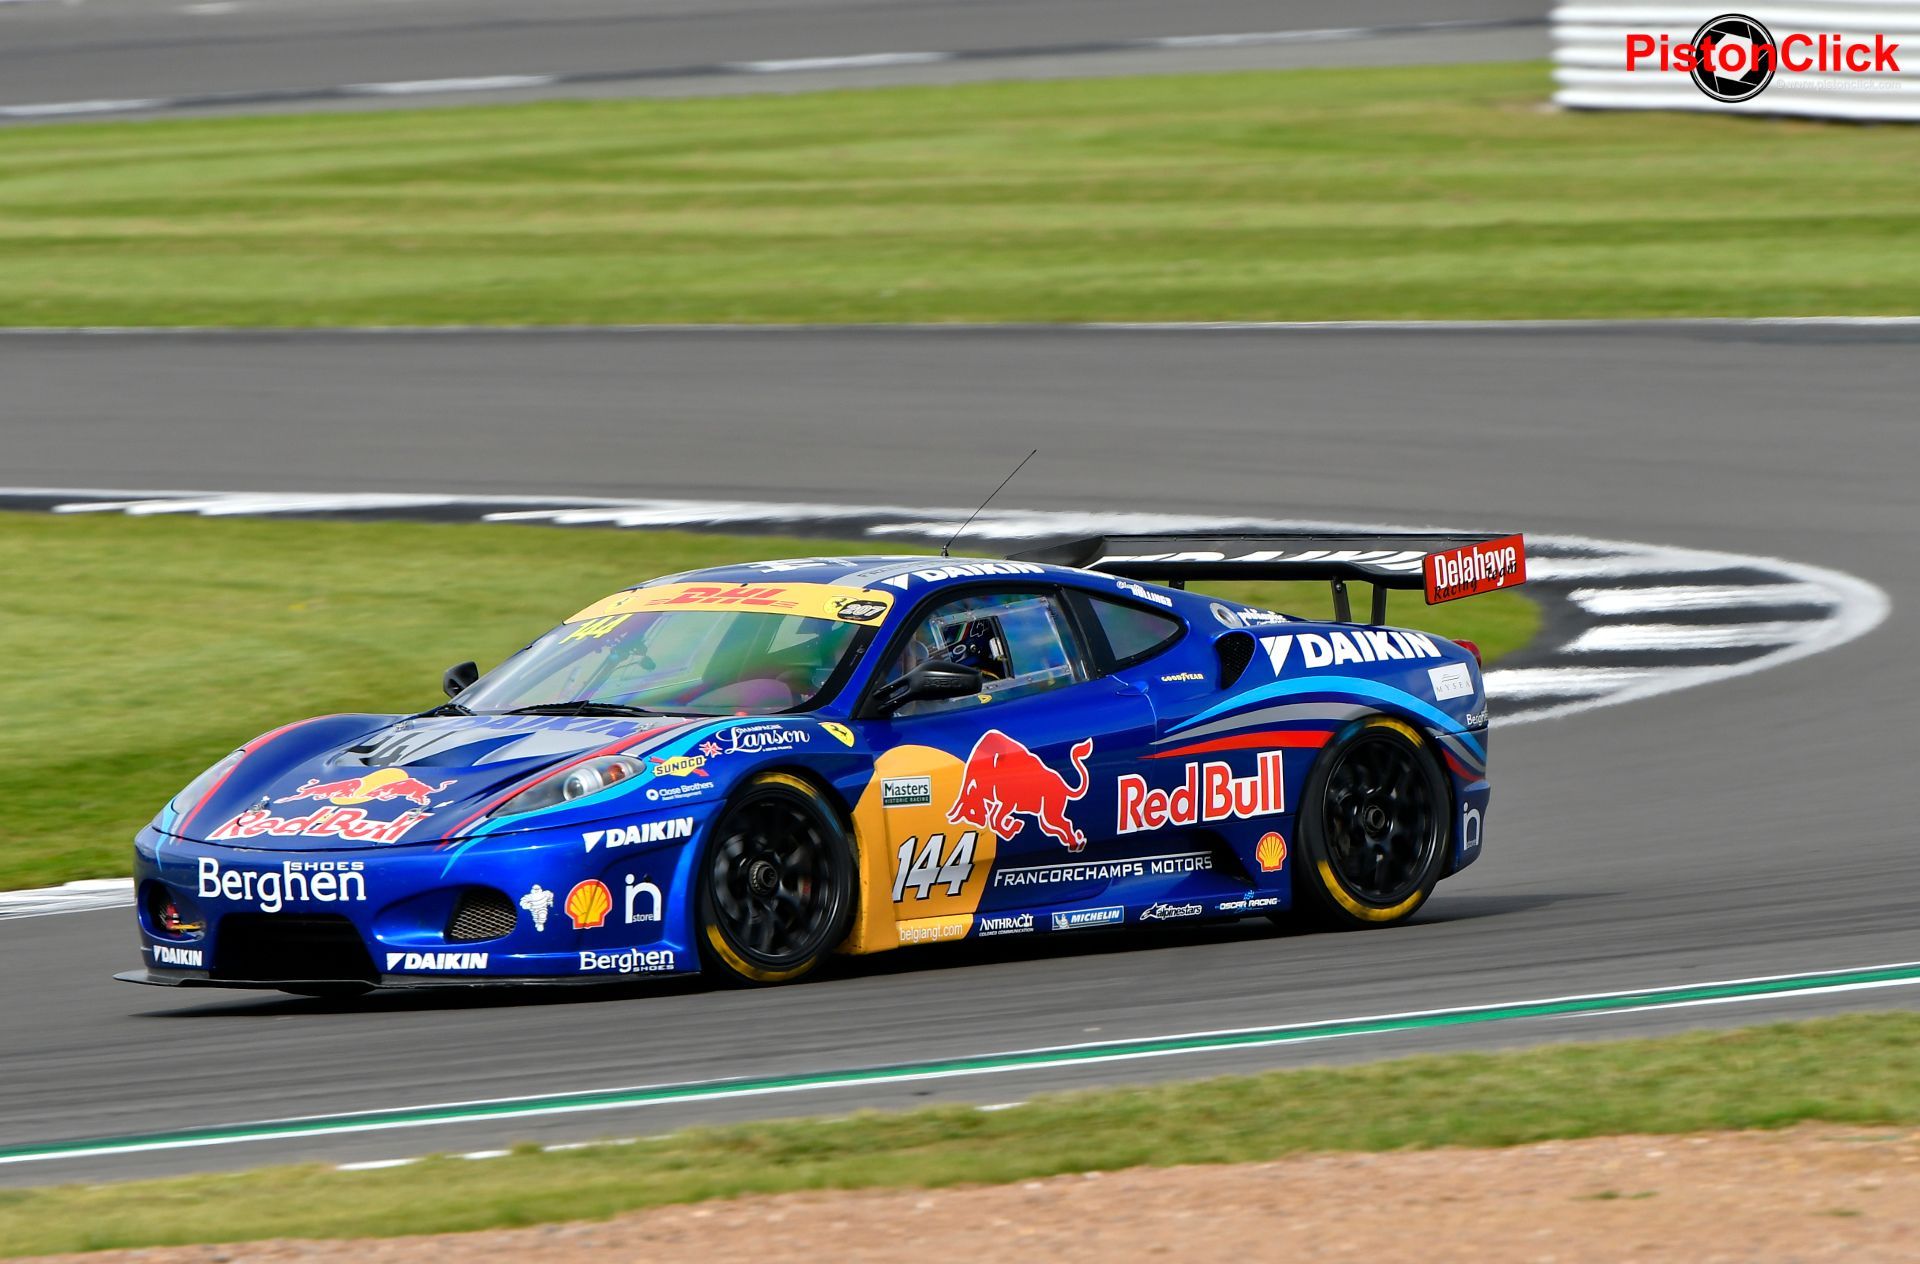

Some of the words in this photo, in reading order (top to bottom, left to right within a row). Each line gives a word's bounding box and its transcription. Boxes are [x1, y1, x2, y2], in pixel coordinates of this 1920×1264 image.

[911, 563, 1046, 582] DAIKIN
[1434, 546, 1516, 588] Delahaye
[663, 587, 787, 606] DHL
[1300, 632, 1442, 669] DAIKIN
[1161, 672, 1205, 682] GOODYEAR
[715, 727, 810, 754] Lanson
[656, 756, 704, 775] SUNOCO
[884, 783, 929, 796] Masters
[1117, 762, 1199, 835] Red
[1203, 750, 1285, 821] Bull
[206, 806, 332, 840] Red
[305, 807, 434, 843] Bull
[606, 817, 693, 848] DAIKIN
[290, 861, 364, 871] SHOES
[892, 831, 979, 903] 144
[994, 862, 1143, 887] FRANCORCHAMPS
[1151, 856, 1213, 874] MOTORS
[198, 857, 366, 913] Berghen
[1156, 903, 1202, 919] alpinestars
[1219, 901, 1246, 910] OSCAR
[1248, 897, 1278, 907] RACING
[632, 913, 654, 922] store
[1071, 910, 1120, 924] MICHELIN
[900, 923, 963, 942] belgiangt.com
[161, 947, 203, 967] DAIKIN
[405, 952, 488, 970] DAIKIN
[579, 948, 674, 973] Berghen
